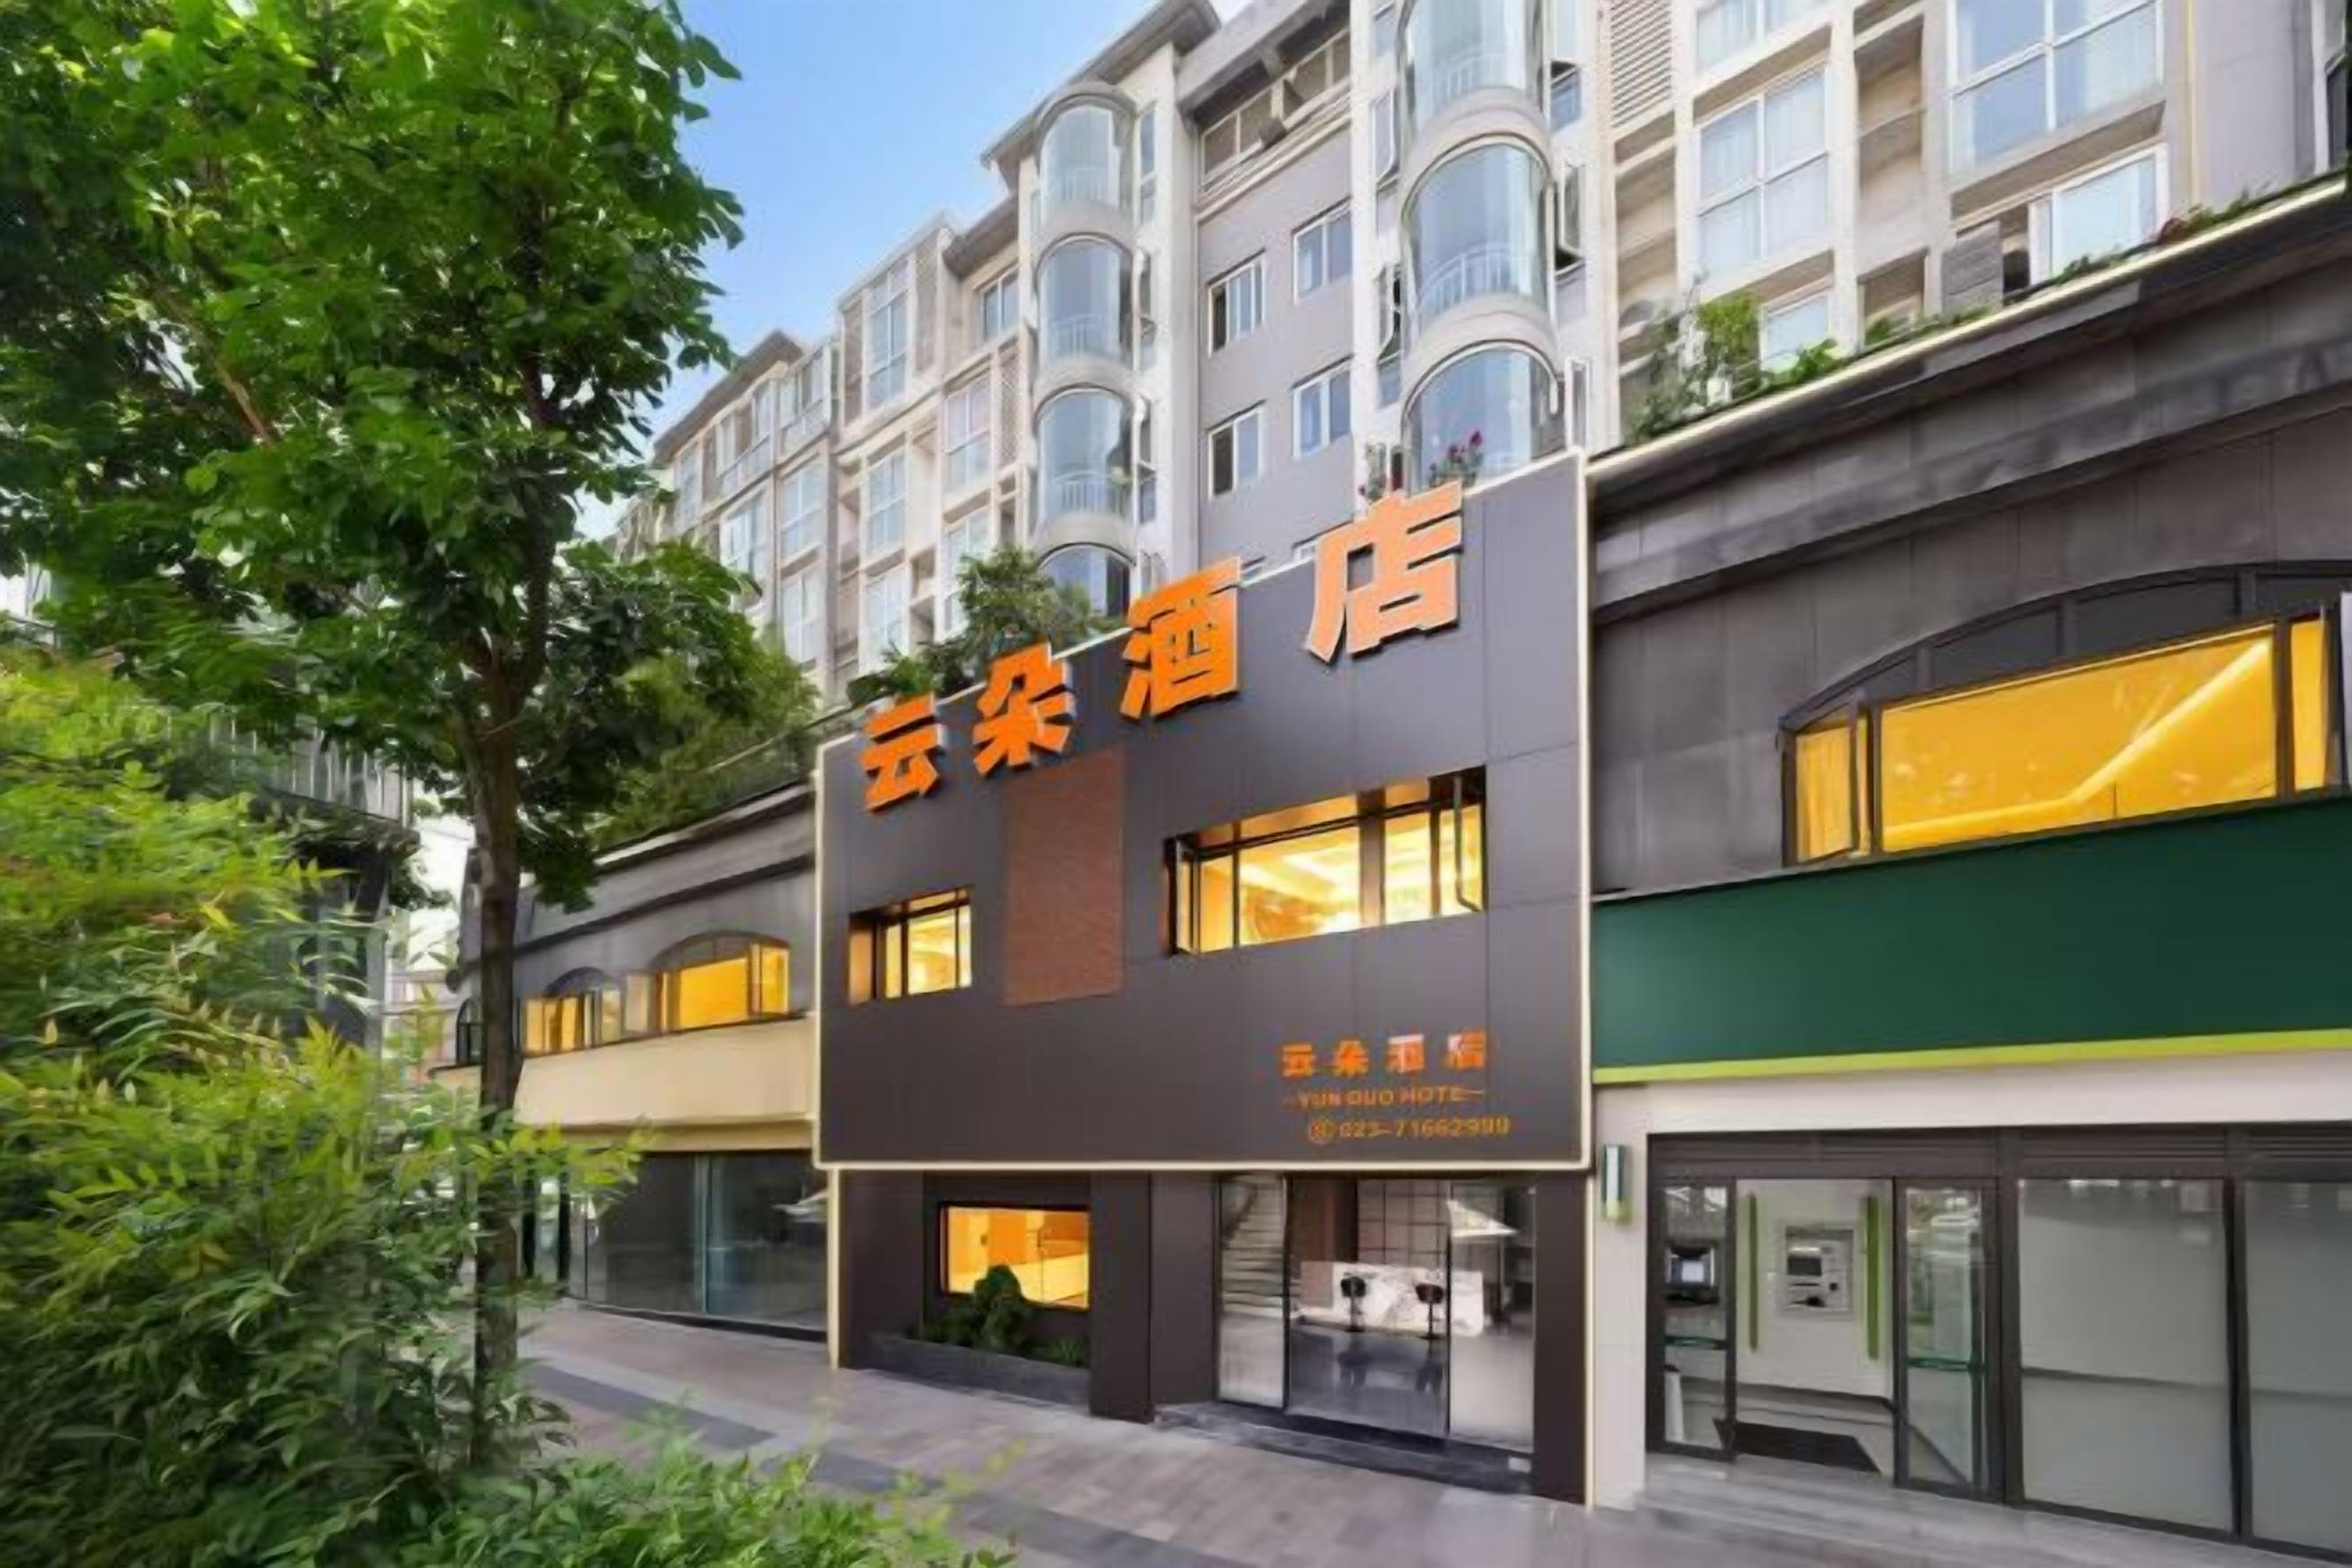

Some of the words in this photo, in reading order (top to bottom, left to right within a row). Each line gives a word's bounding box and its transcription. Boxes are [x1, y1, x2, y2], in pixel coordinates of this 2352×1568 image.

[861, 482, 1463, 811] 云朵酒店
[1281, 1030, 1486, 1078] 云朵酒店
